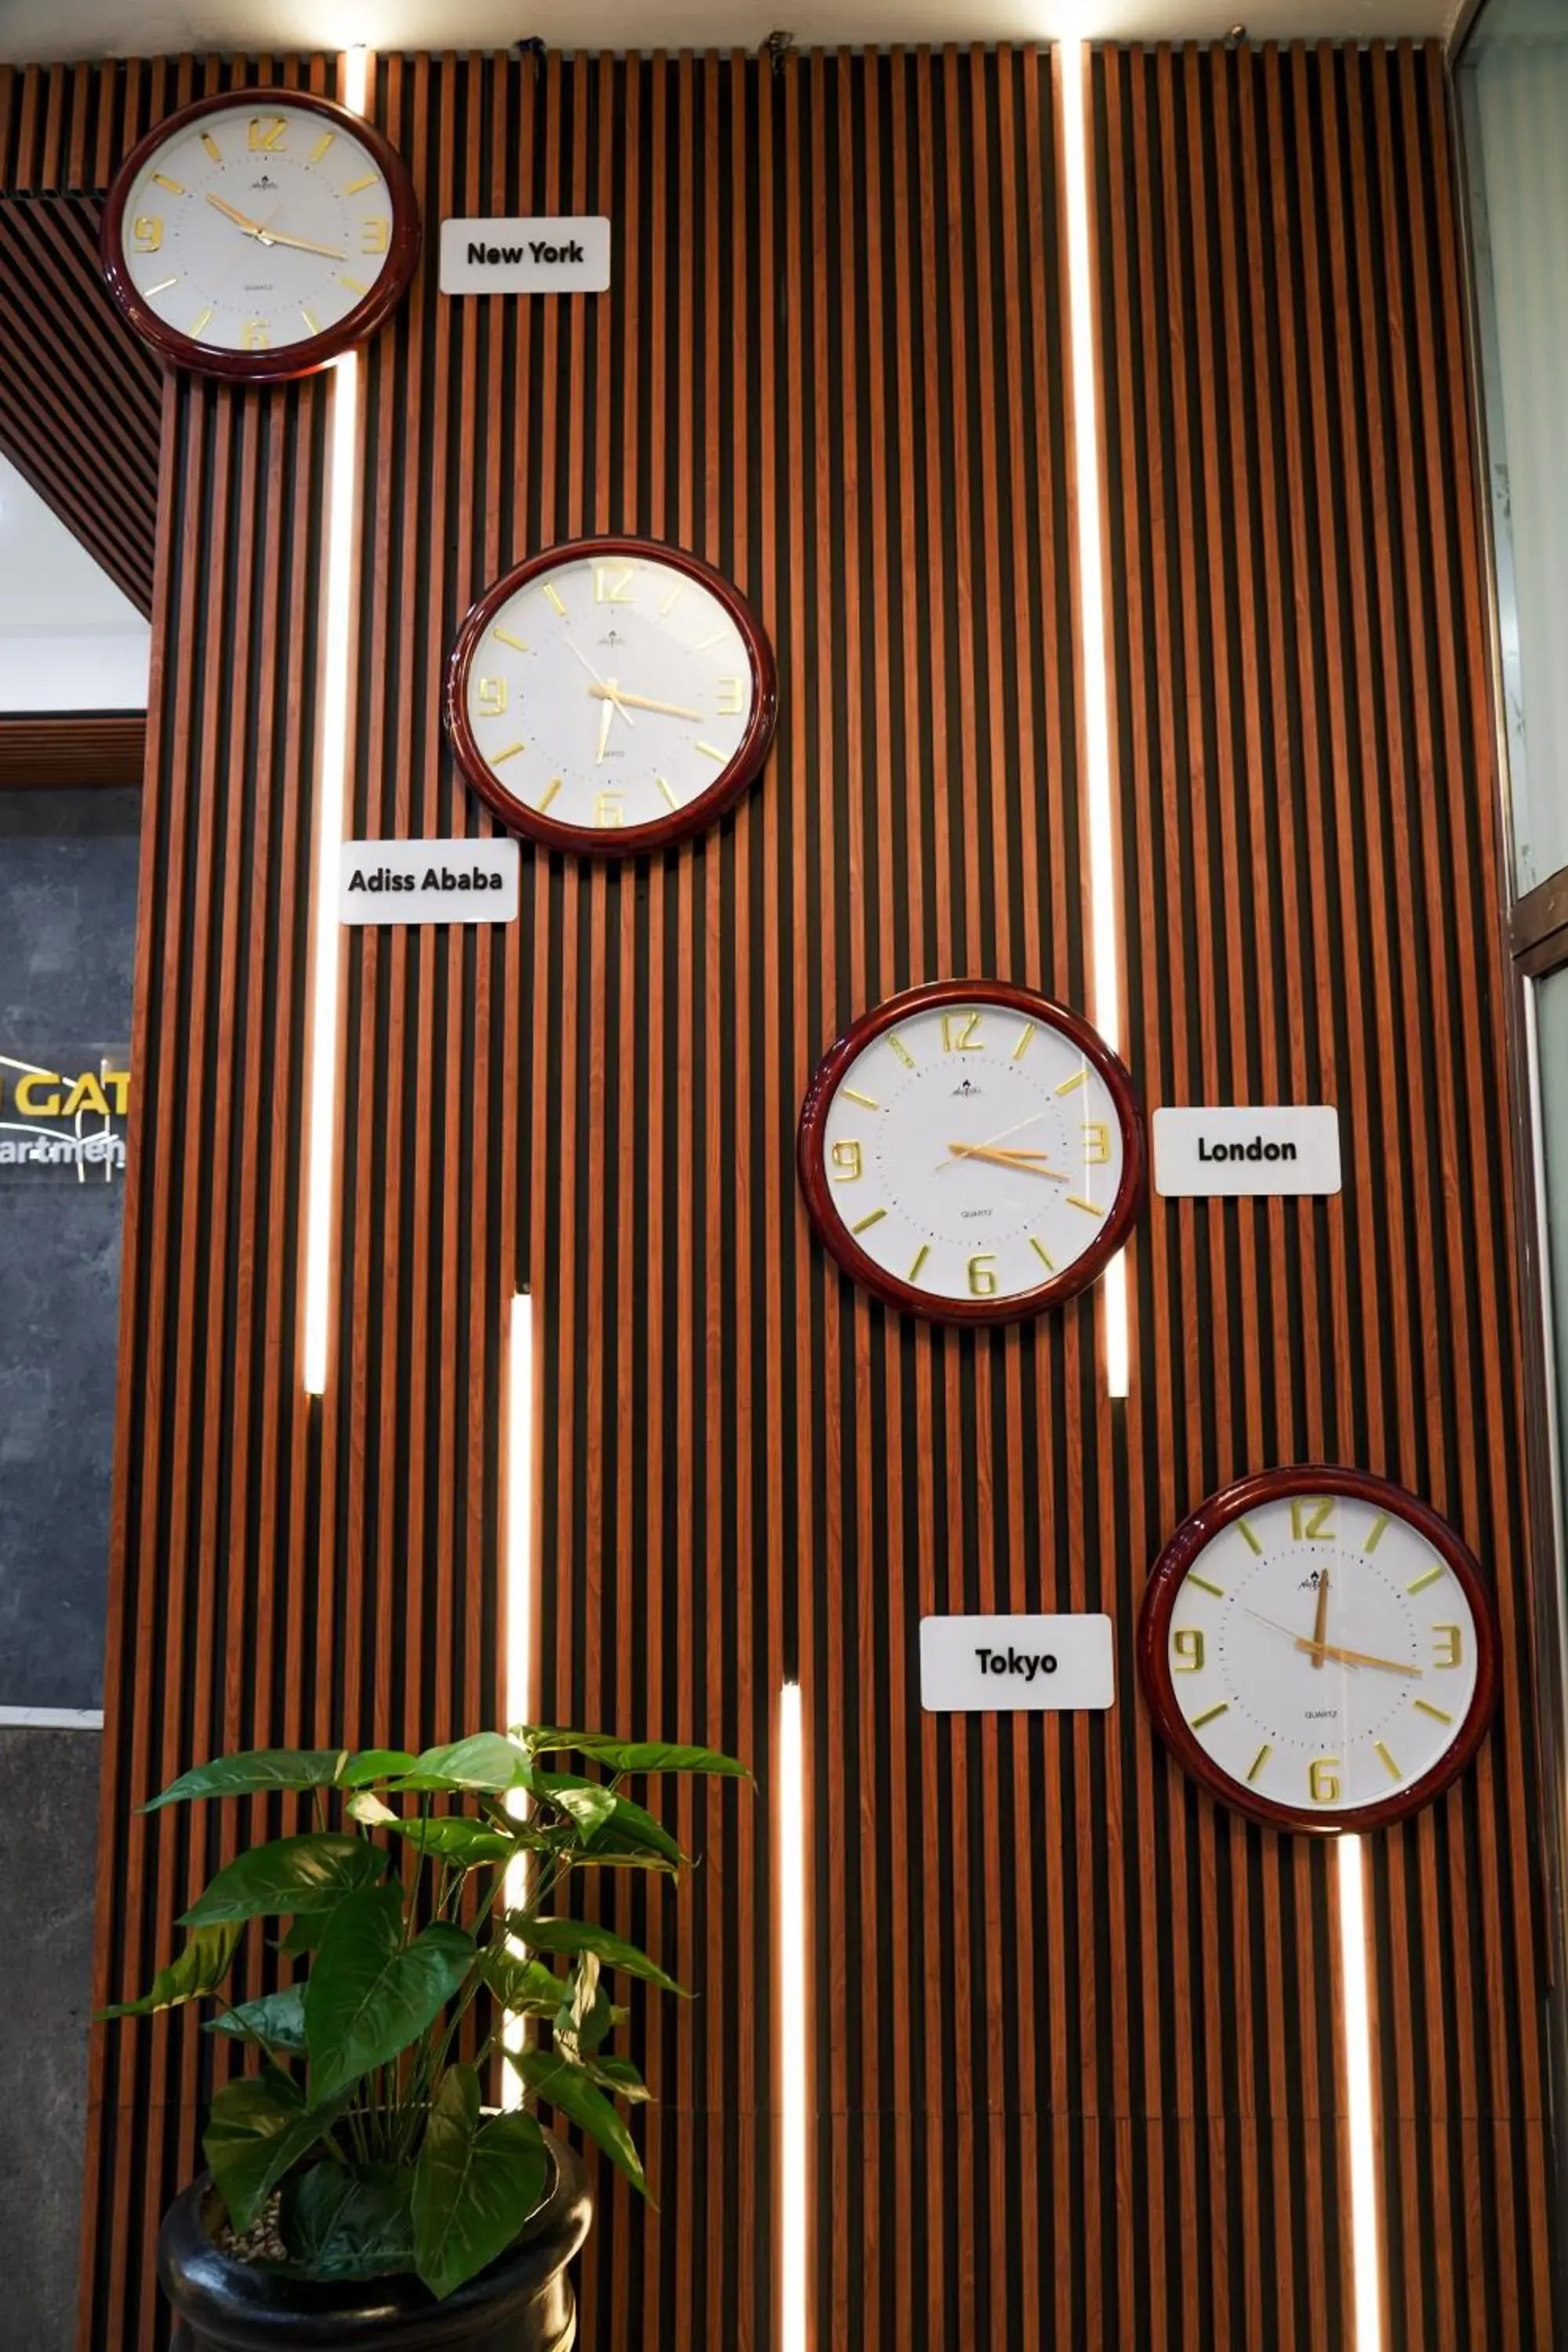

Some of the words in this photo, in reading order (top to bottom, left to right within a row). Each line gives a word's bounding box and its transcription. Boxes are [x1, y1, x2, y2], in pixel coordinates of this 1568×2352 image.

[249, 117, 288, 152] 12
[134, 216, 164, 252] 9
[361, 217, 388, 253] 3
[468, 242, 523, 266] New
[529, 241, 583, 263] York
[241, 321, 271, 350] 6
[593, 565, 637, 603] 12
[477, 677, 506, 716] 9
[716, 677, 743, 715] 3
[594, 792, 625, 829] 6
[348, 869, 416, 893] Adiss
[421, 867, 503, 891] Ababa
[942, 1011, 983, 1051] 12
[832, 1141, 862, 1182] 9
[1080, 1124, 1110, 1163] 3
[1198, 1137, 1297, 1162] London
[967, 1254, 996, 1295] 6
[1291, 1496, 1336, 1541] 12
[975, 1647, 1058, 1682] Tokyo
[1174, 1628, 1205, 1673] 9
[1432, 1625, 1461, 1668] 3
[1309, 1759, 1340, 1802] 6
